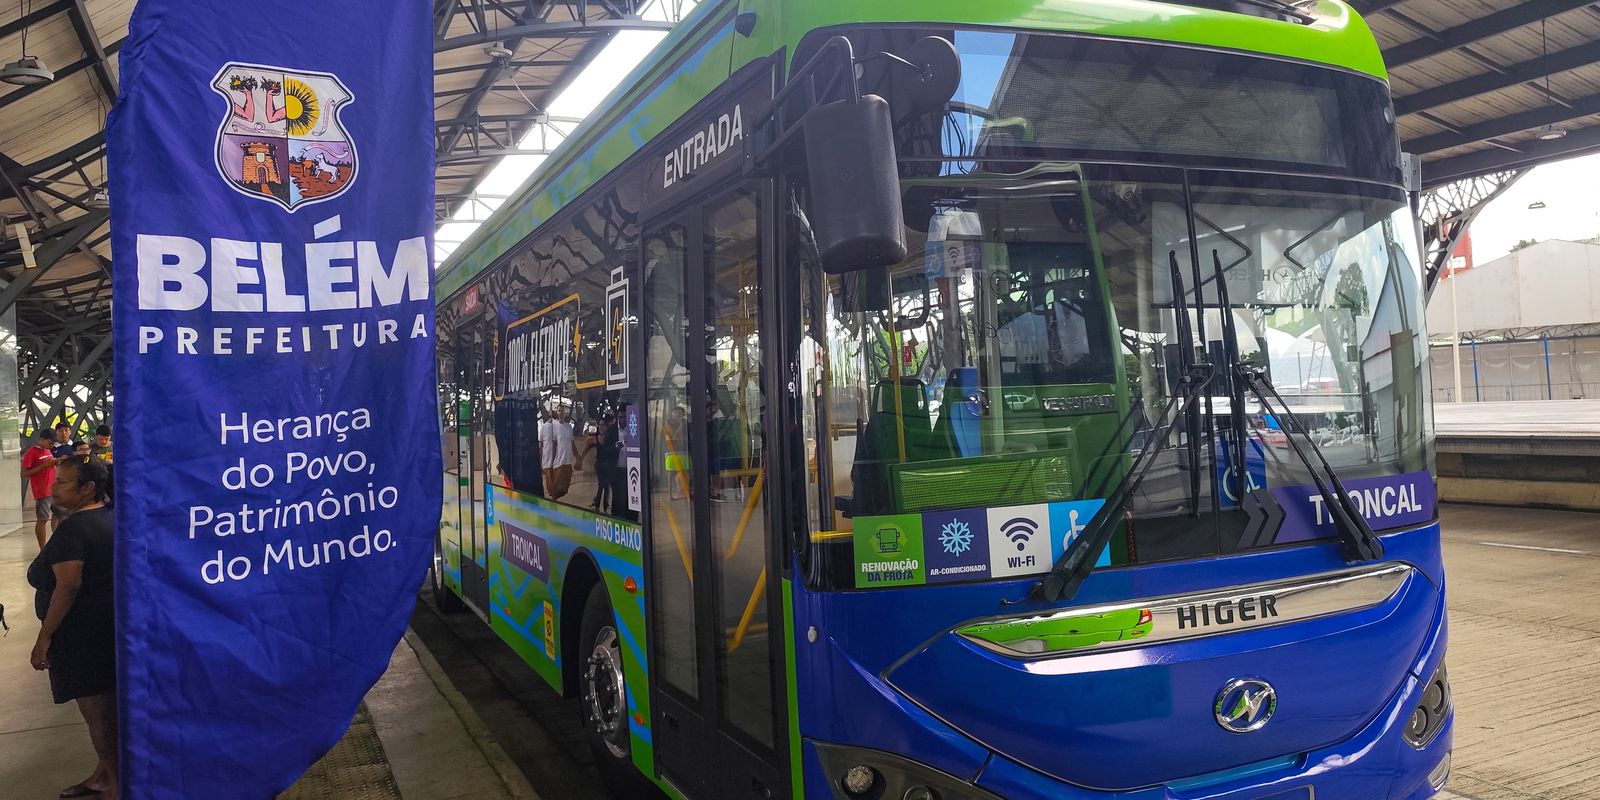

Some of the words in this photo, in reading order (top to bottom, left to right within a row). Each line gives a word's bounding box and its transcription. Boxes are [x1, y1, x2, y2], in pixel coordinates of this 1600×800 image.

[664, 104, 743, 188] ENTRADA
[136, 214, 430, 312] BELÉM
[139, 314, 427, 355] PREFEITURA
[507, 332, 528, 393] 100%
[530, 316, 570, 389] ELÉTRICO
[220, 407, 371, 445] Herança
[221, 457, 274, 490] do
[286, 450, 376, 484] Povo,
[189, 482, 398, 539] Patrimônio
[511, 533, 543, 571] TRONCAL
[595, 518, 612, 541] PISO
[615, 524, 642, 551] BAIXO
[200, 550, 251, 584] do
[263, 525, 397, 575] Mundo.
[861, 558, 919, 575] RENOVAÇÃO
[930, 564, 987, 576] AR-CONDICIONADO
[1007, 555, 1036, 569] WI-FI
[867, 572, 881, 582] DA
[884, 569, 914, 581] FROTA
[1177, 594, 1278, 630] HIGER
